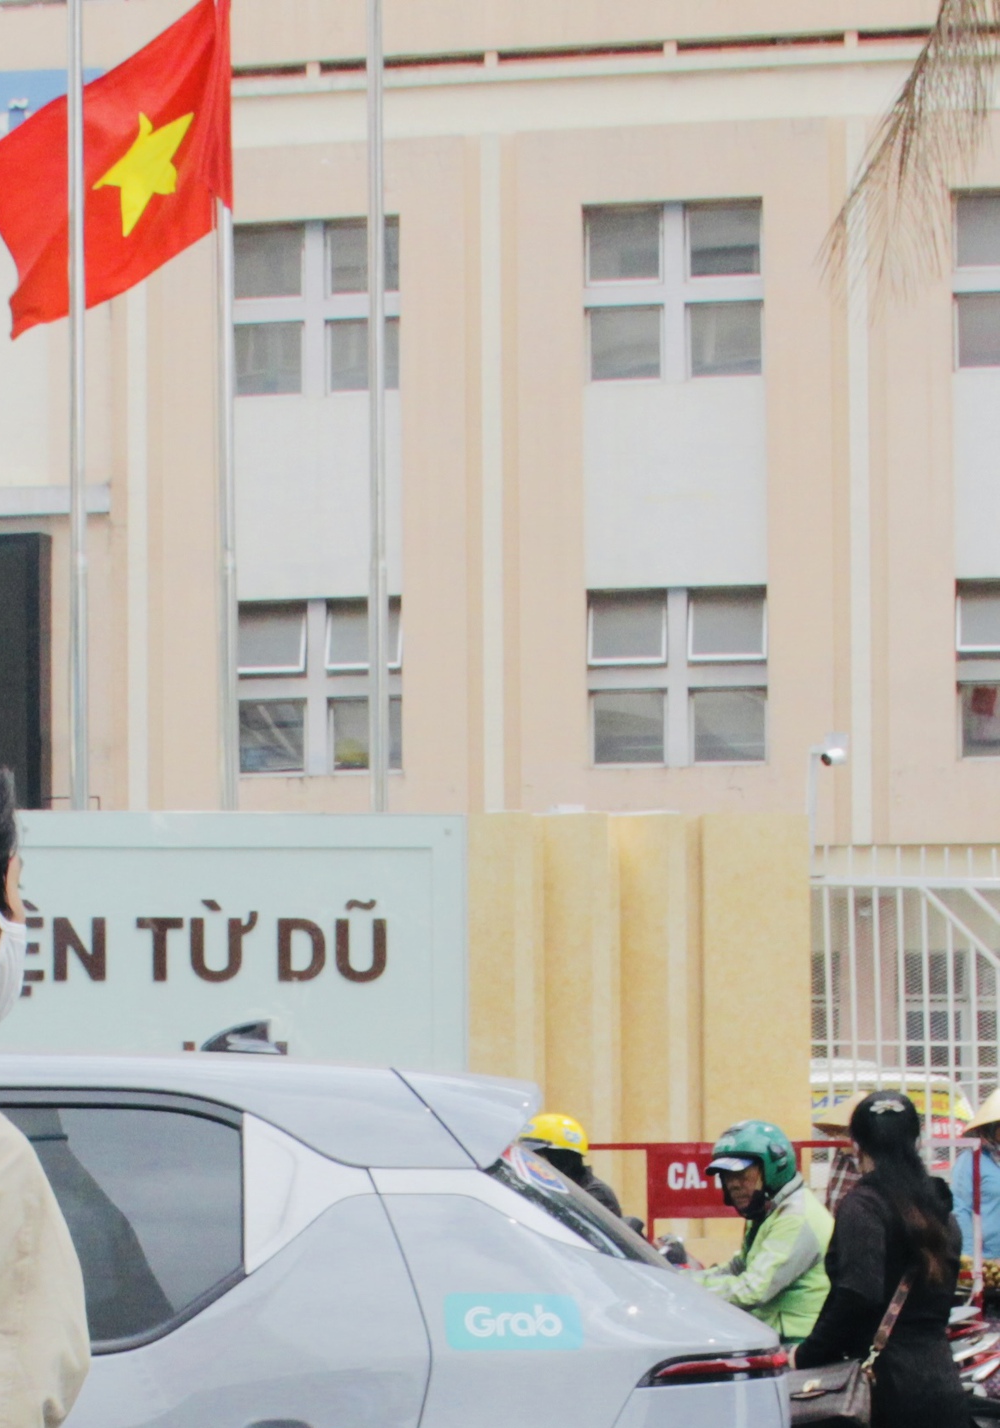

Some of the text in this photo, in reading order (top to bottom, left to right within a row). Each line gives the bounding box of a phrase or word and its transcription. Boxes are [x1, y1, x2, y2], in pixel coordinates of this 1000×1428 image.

[136, 899, 258, 983] TỪ
[277, 899, 388, 983] DŨ
[464, 1304, 563, 1337] Grab
